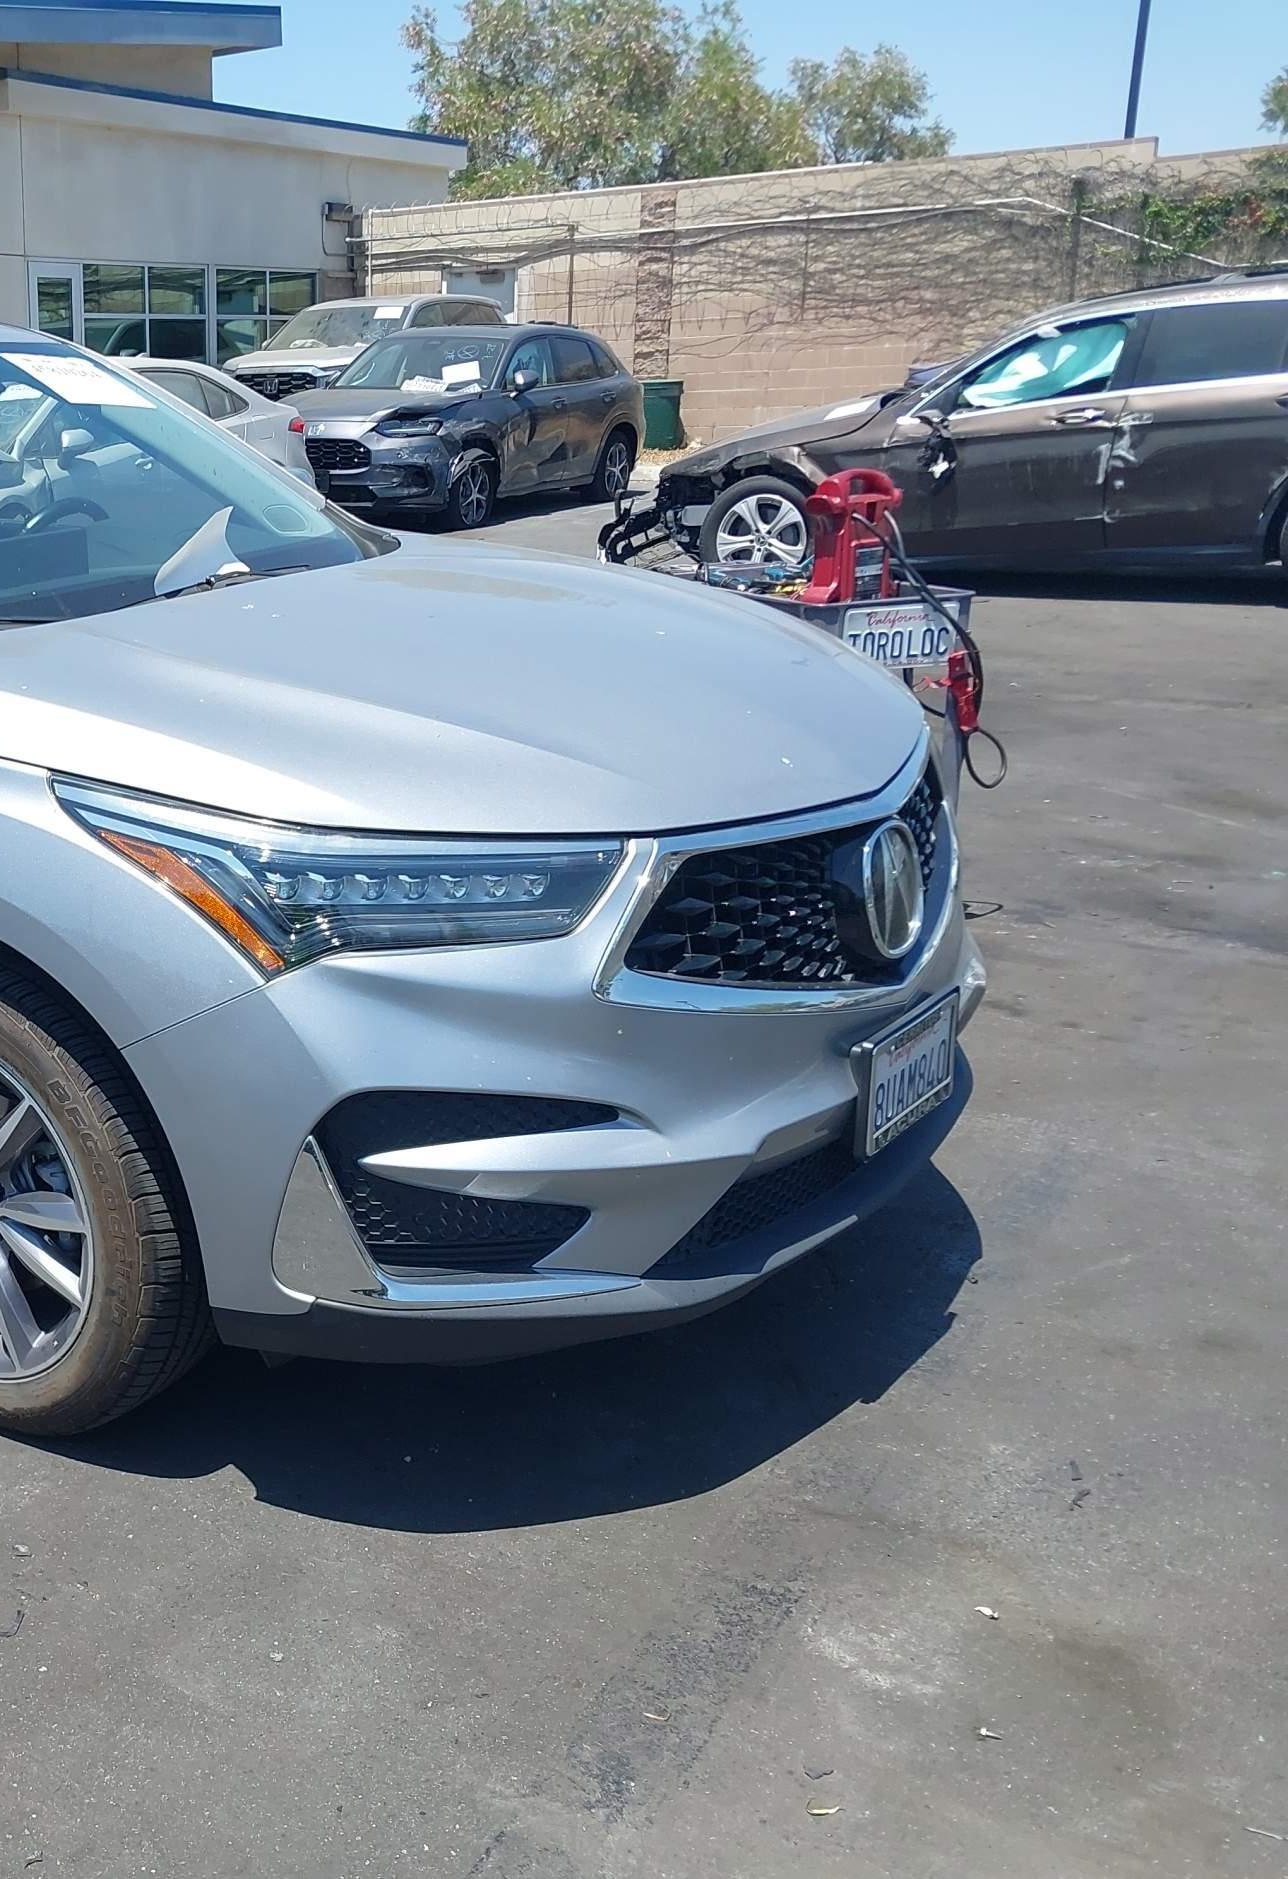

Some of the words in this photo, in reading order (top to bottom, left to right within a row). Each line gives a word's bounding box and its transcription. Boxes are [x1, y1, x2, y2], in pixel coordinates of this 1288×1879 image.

[867, 610, 936, 628] California
[874, 1038, 948, 1131] 8UAM840
[887, 1095, 938, 1142] ACURA
[47, 1079, 131, 1328] BFGoodrich
